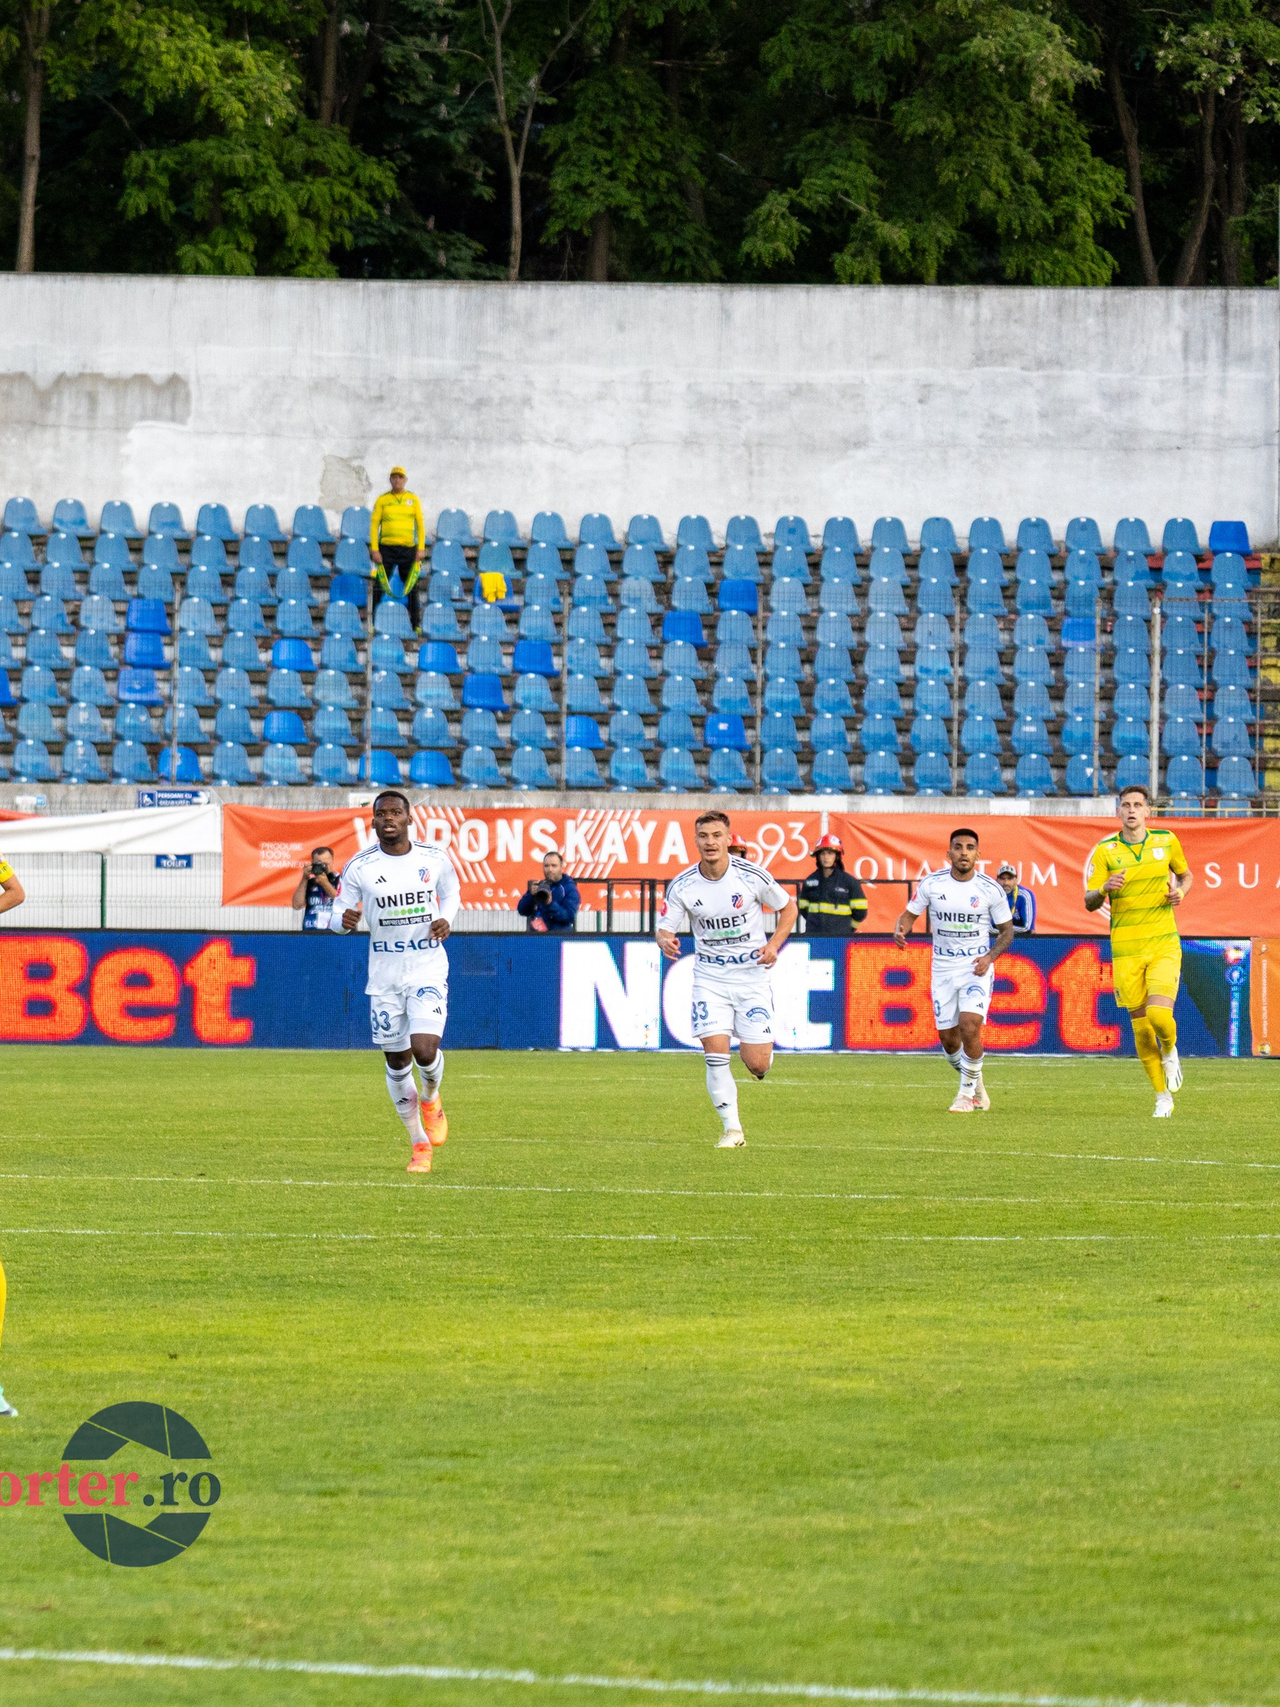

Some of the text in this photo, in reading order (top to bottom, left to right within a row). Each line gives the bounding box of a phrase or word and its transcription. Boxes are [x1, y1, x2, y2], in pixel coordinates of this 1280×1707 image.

[261, 842, 303, 850] PRODUSE
[352, 816, 689, 865] VRONSKAYA
[261, 850, 291, 860] 100%
[161, 859, 188, 868] TOILET
[1204, 862, 1280, 889] SU
[375, 889, 434, 909] UNIBET
[698, 913, 749, 930] UNIBET
[936, 911, 983, 924] UNIBET
[372, 937, 440, 953] ELSACO
[933, 945, 988, 958] ELSACO
[698, 949, 761, 966] ELSACO
